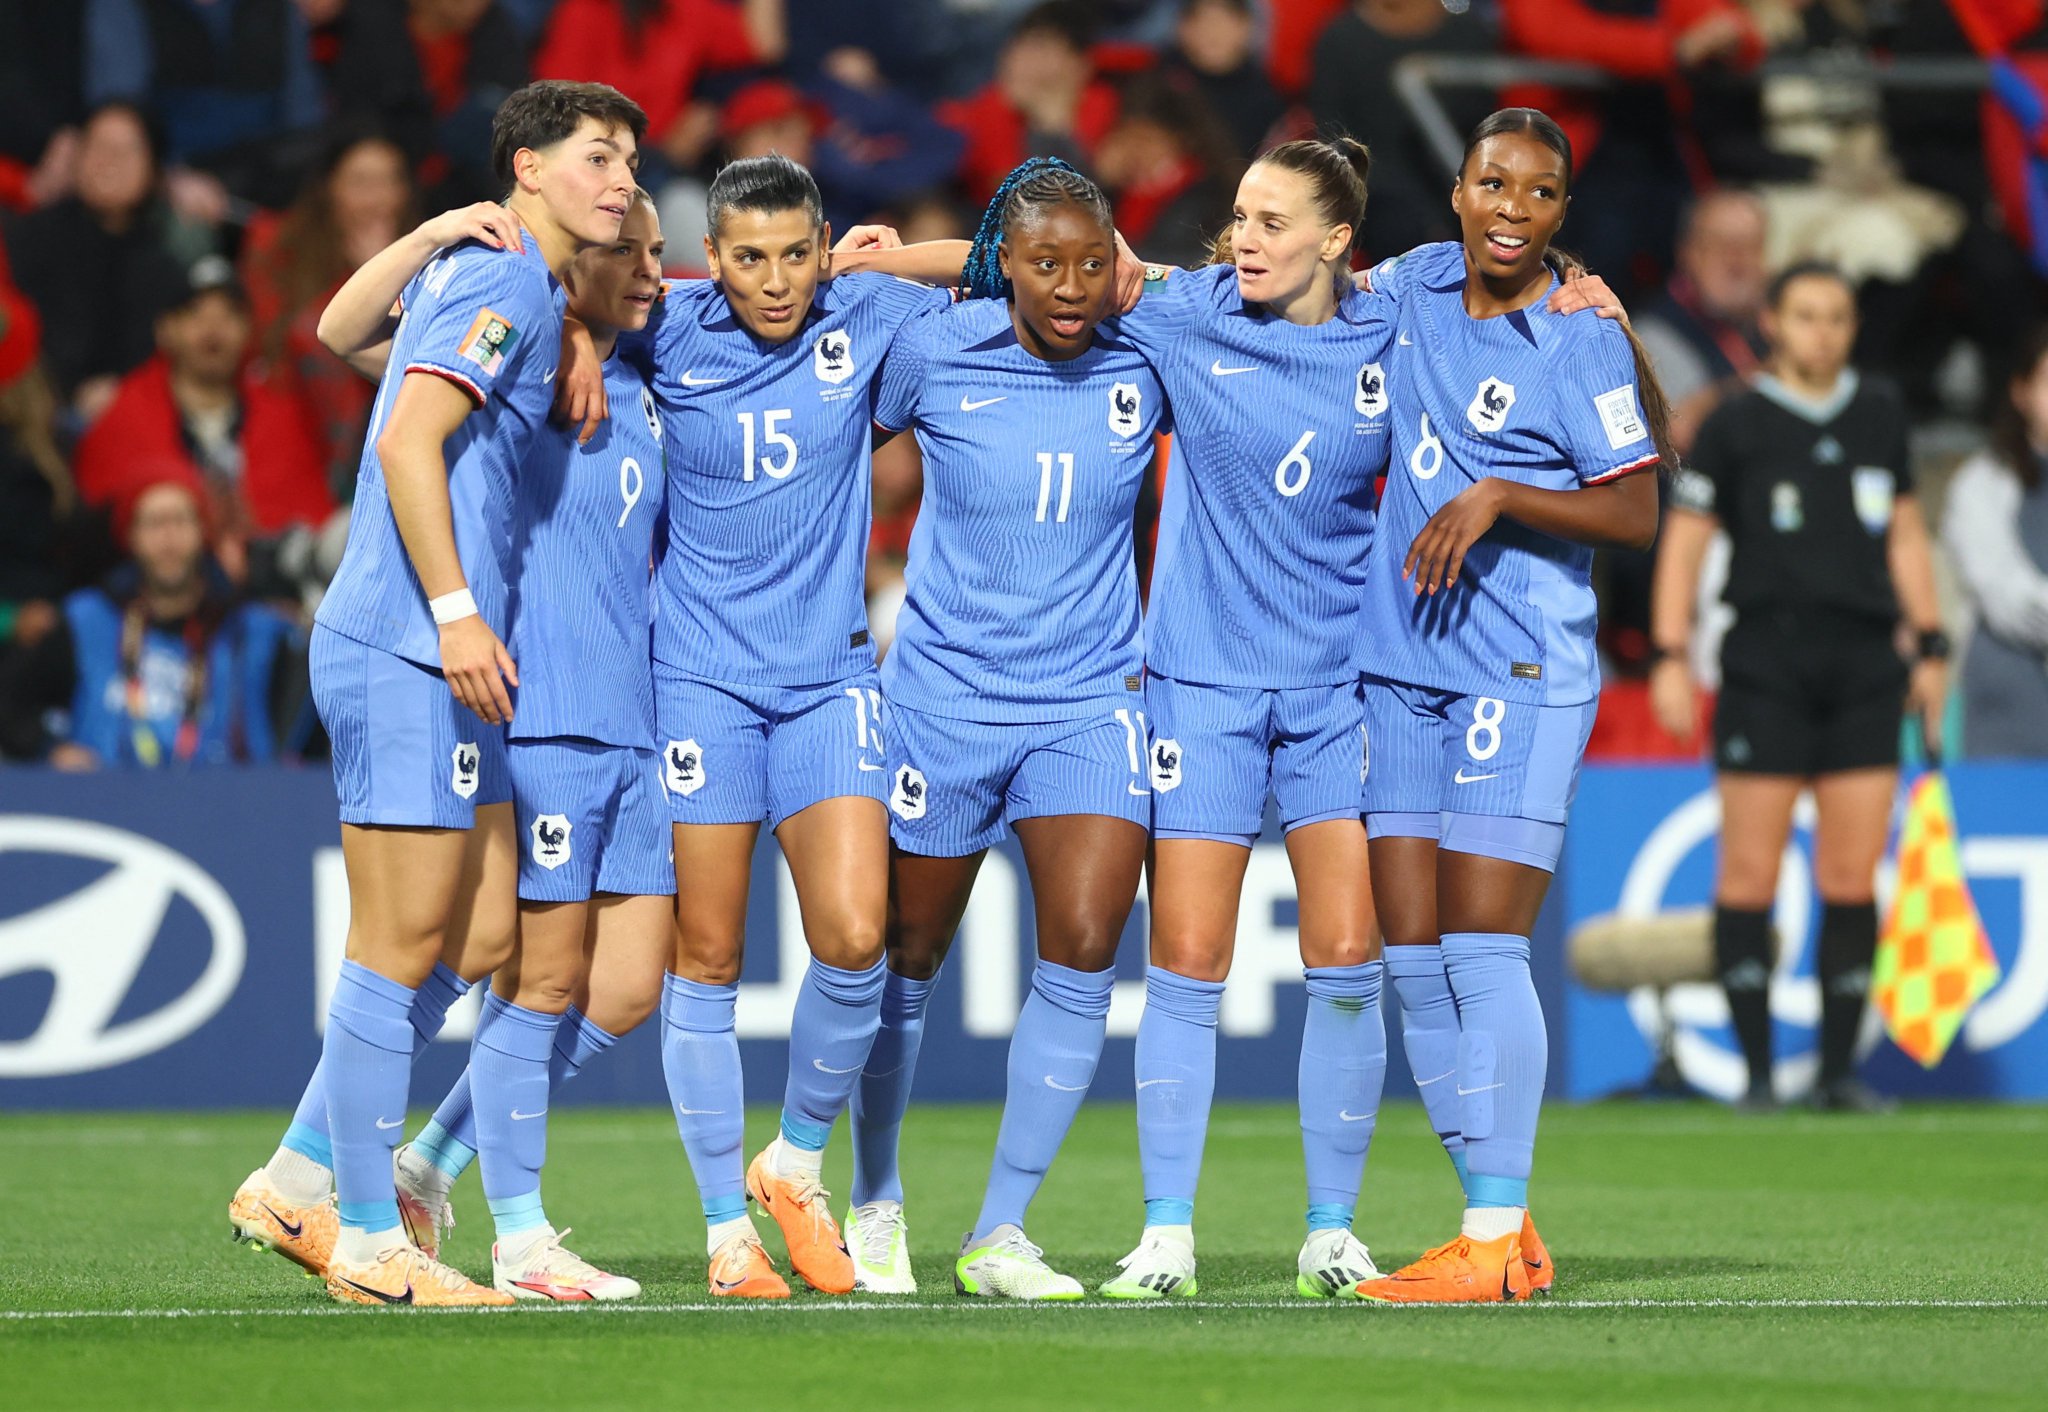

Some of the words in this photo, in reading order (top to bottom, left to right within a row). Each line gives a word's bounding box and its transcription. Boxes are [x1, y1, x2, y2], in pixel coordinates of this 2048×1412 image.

[737, 408, 798, 481] 15
[1275, 430, 1316, 497] 6
[617, 456, 644, 528] 9
[1035, 452, 1074, 523] 11
[1466, 696, 1506, 761] 8
